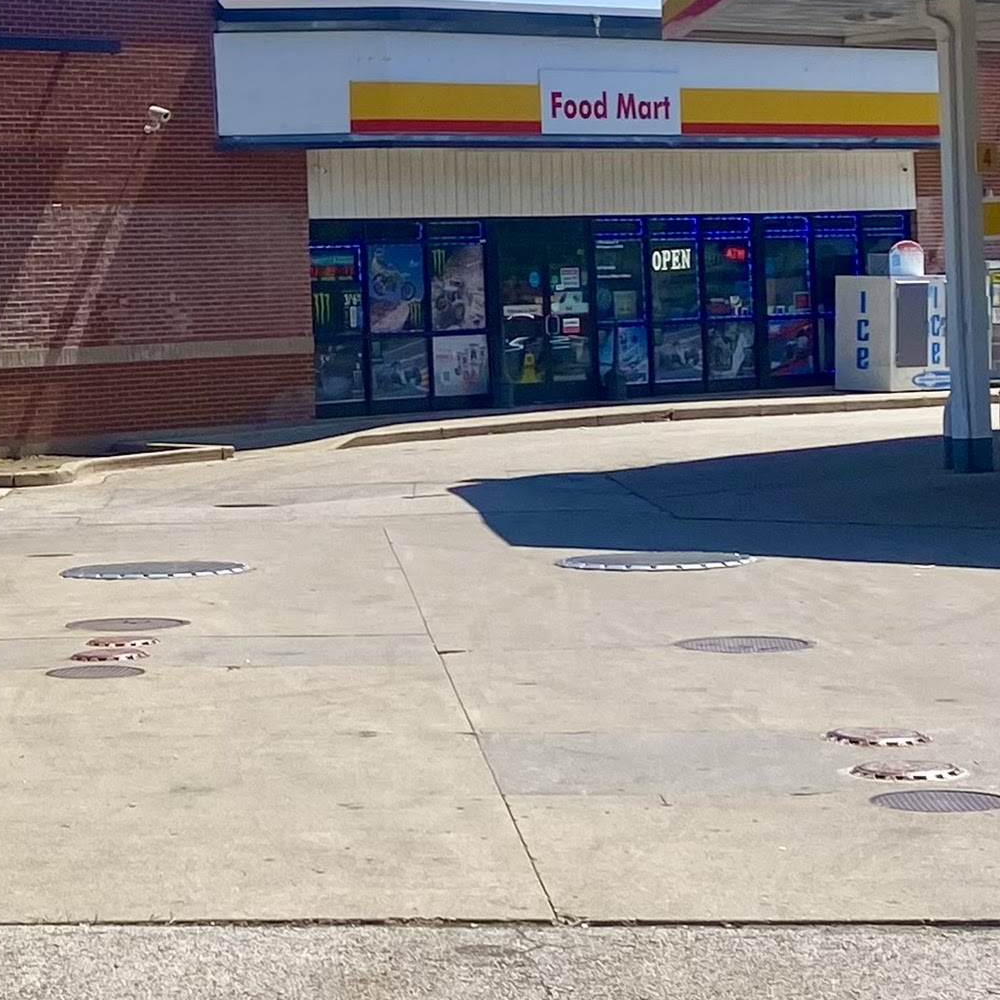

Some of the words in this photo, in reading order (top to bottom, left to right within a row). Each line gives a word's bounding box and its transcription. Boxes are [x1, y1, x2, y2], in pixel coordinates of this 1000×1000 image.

[551, 91, 608, 119] Food
[616, 93, 671, 120] Mart
[652, 248, 691, 271] OPEN
